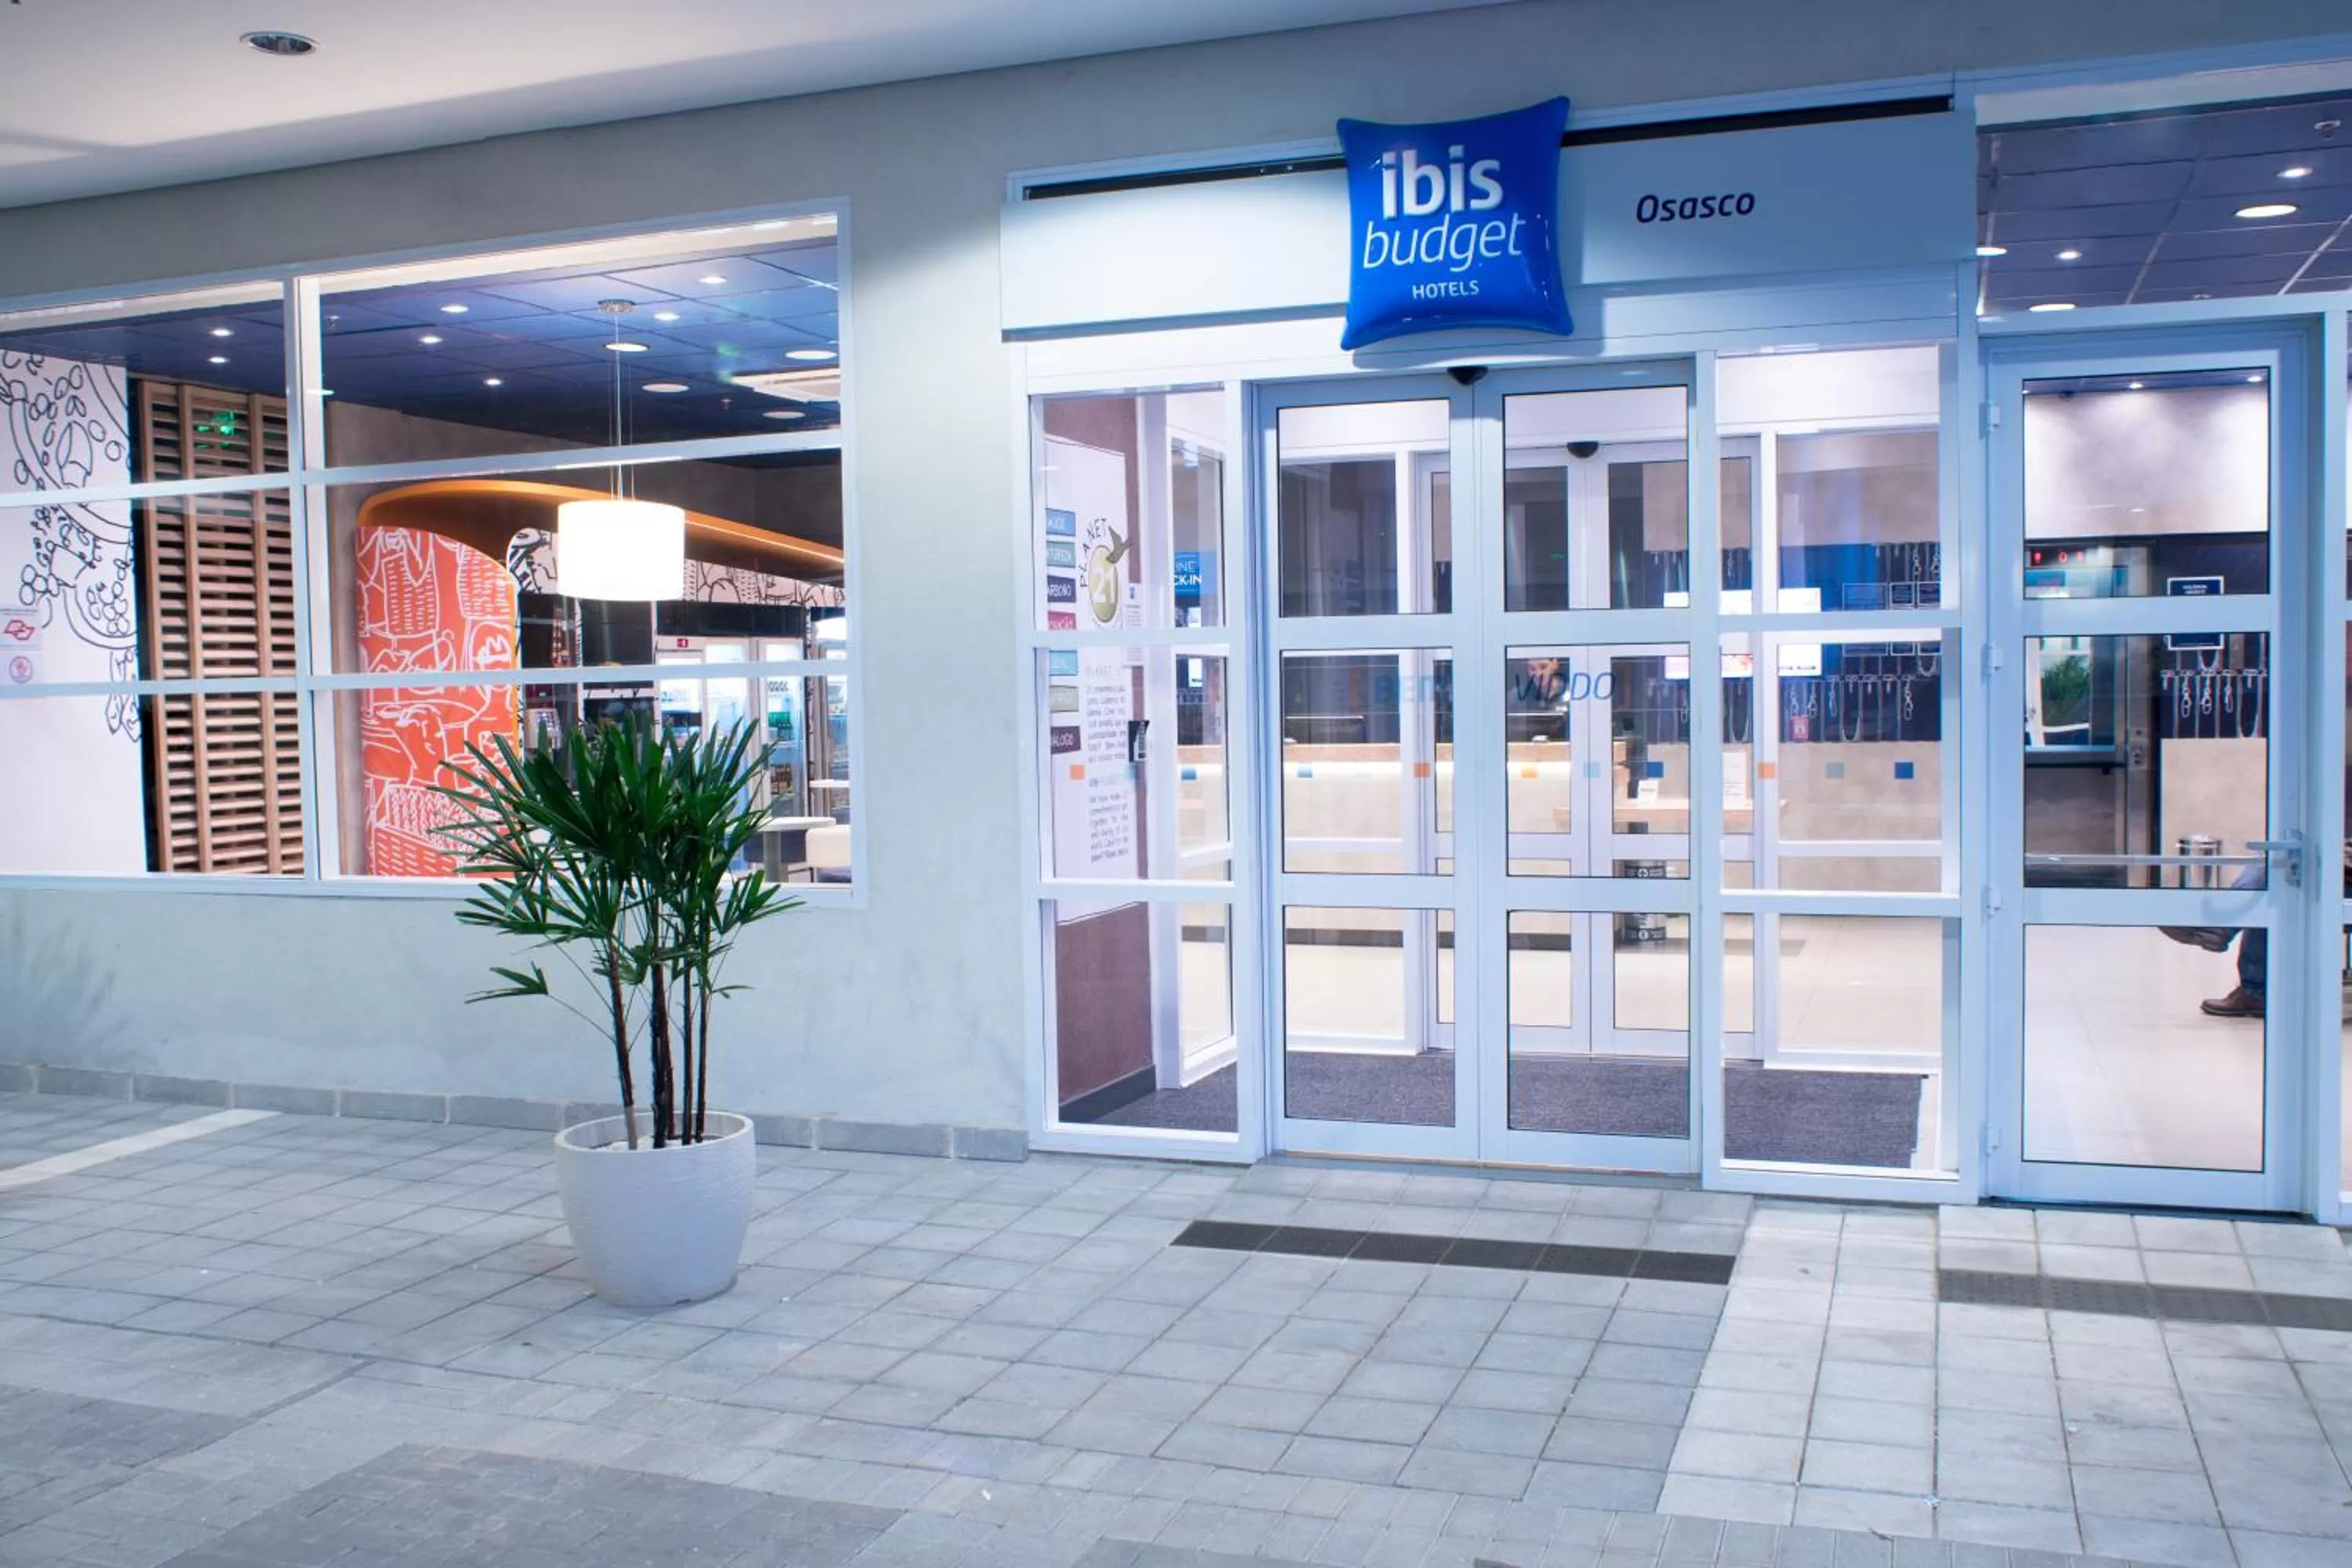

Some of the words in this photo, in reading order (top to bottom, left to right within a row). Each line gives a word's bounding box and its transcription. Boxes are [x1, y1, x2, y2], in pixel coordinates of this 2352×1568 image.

[1381, 145, 1504, 220] ibis
[1636, 193, 1755, 223] Osasco
[1363, 212, 1526, 272] budget
[1412, 280, 1479, 299] HOTELS
[1173, 574, 1202, 586] CK-IN
